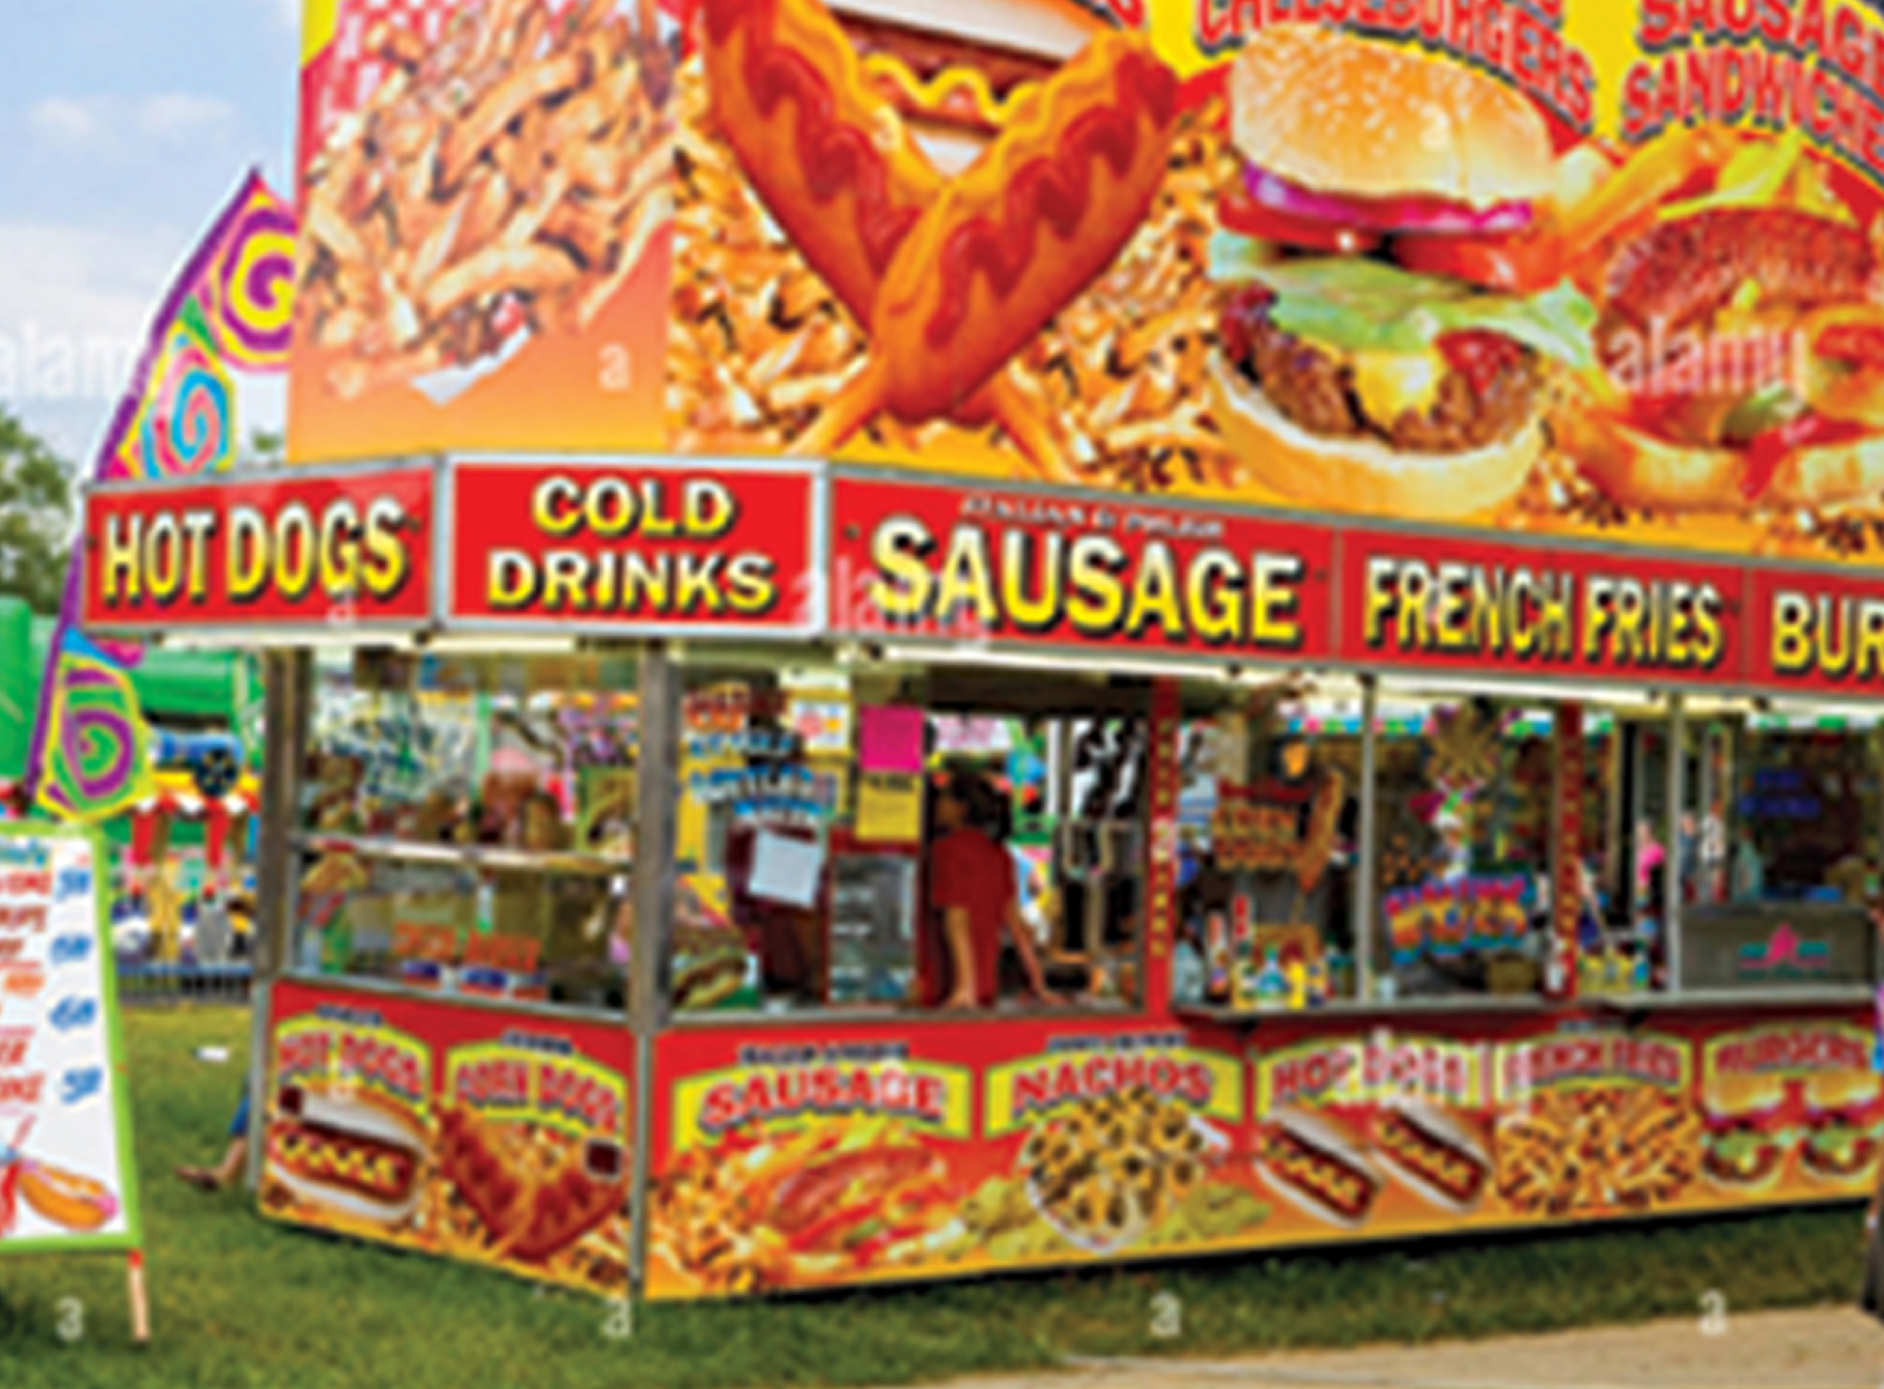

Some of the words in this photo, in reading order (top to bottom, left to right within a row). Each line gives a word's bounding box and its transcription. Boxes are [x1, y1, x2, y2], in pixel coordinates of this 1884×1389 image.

[1198, 0, 1592, 132] CURGERS
[104, 511, 215, 606] HOT
[226, 497, 410, 601] DOGS
[532, 476, 741, 540] COLD
[487, 550, 778, 617] DRINKS
[870, 515, 1304, 649] SAUSAGE
[1364, 554, 1575, 660] FRENCH
[1584, 572, 1723, 667] FRIES
[1772, 590, 1884, 678] BUR
[697, 1066, 948, 1132] SAUSAGE
[1010, 1056, 1212, 1119] NACHOS
